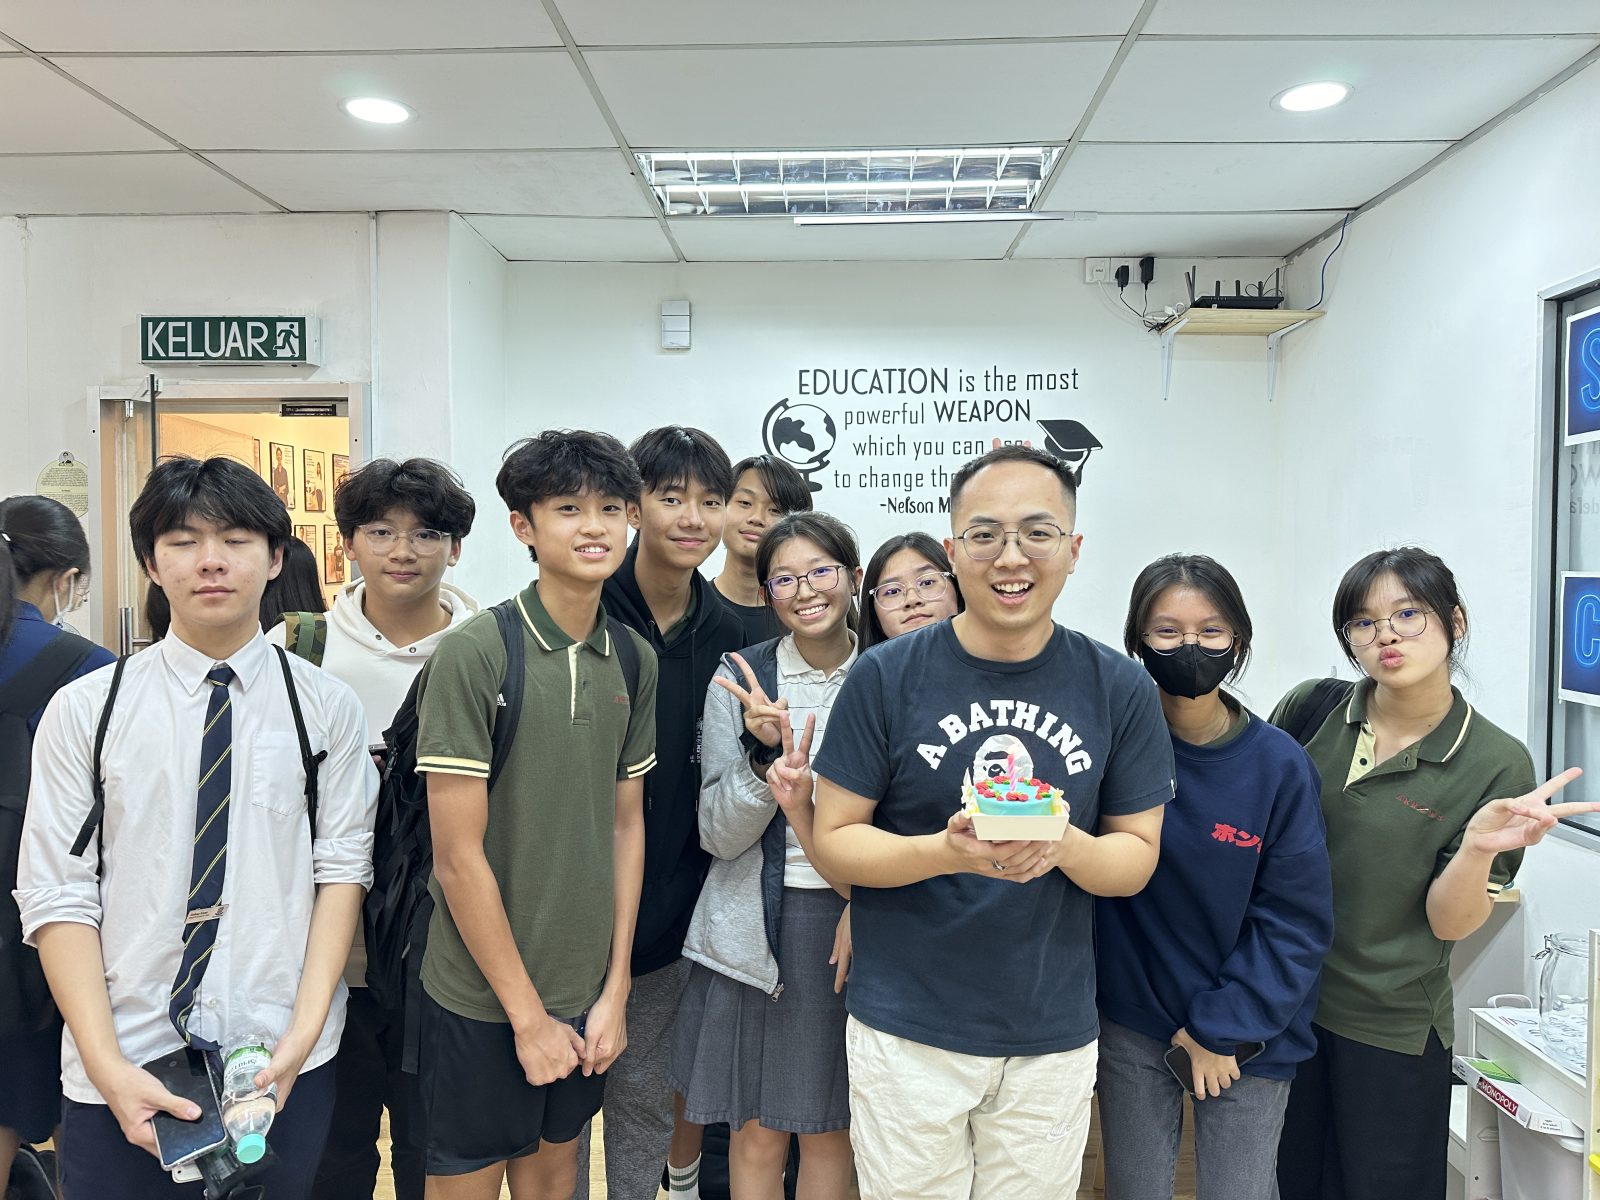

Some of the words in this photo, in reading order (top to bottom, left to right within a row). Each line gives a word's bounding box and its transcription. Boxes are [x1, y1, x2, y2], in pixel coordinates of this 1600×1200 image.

[147, 321, 269, 358] KELUAR
[798, 367, 948, 396] EDUCATION
[959, 368, 975, 392] is
[983, 364, 1017, 392] the
[1026, 367, 1079, 391] most
[844, 402, 925, 431] powerful
[933, 398, 1031, 424] WEAPON
[852, 433, 906, 457] which
[913, 441, 945, 461] you
[952, 440, 984, 455] can
[834, 469, 851, 488] to
[859, 465, 924, 492] change
[938, 496, 951, 514] M
[916, 743, 948, 771] A
[937, 699, 1093, 776] BATHING
[1481, 1081, 1518, 1112] MONOPOLY
